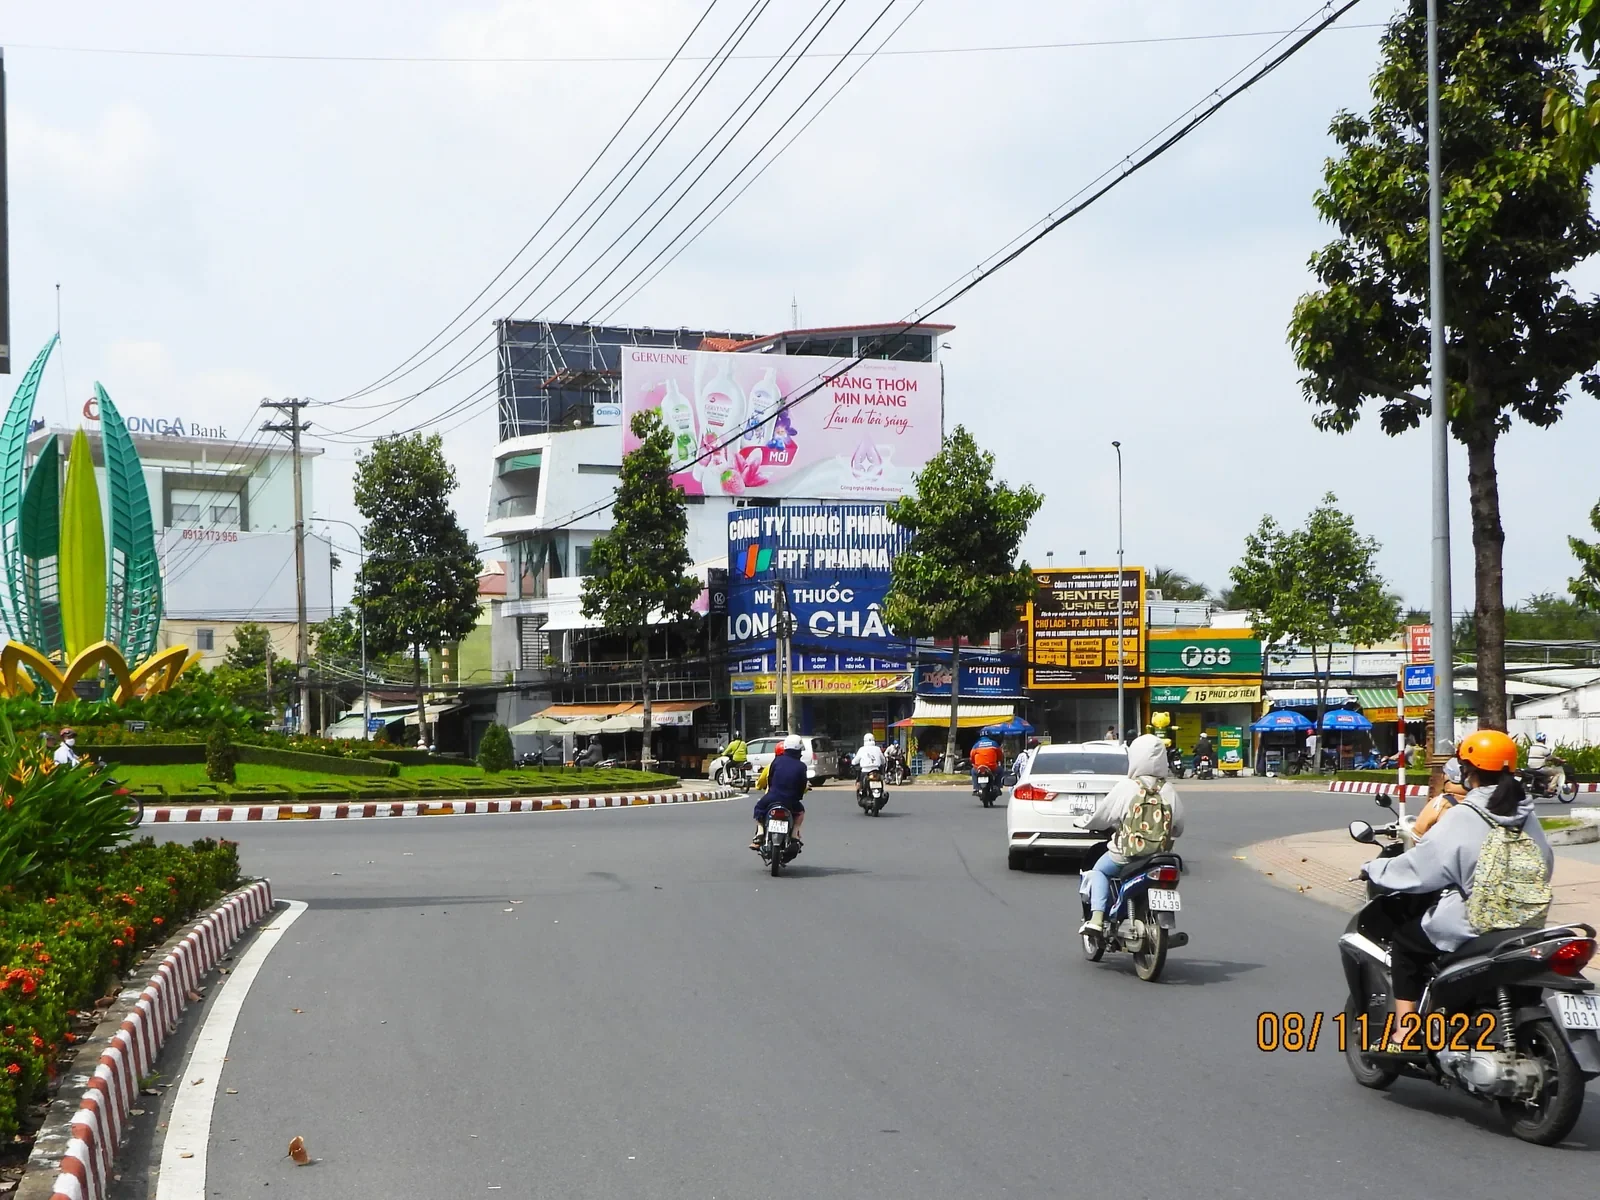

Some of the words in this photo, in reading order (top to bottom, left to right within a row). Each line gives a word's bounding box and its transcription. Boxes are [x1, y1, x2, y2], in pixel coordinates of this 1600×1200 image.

[632, 352, 688, 365] GERVENNE
[822, 372, 872, 390] TRẮNG
[876, 378, 917, 392] THƠM
[834, 392, 860, 407] MỊN
[864, 391, 907, 407] MÀNG
[123, 416, 186, 436] ONGA
[190, 422, 228, 439] Bank
[851, 409, 864, 424] da
[884, 414, 914, 435] sáng
[769, 450, 789, 463] MỚI
[183, 529, 203, 540] 0913
[206, 530, 220, 541] 173
[222, 531, 238, 542] 956
[729, 516, 760, 541] CÔNG
[764, 516, 786, 536] TY
[778, 549, 809, 569] FPT
[814, 549, 890, 569] PHARMA
[793, 581, 854, 604] THUỐC
[1035, 619, 1049, 630] CHỢ
[1050, 617, 1066, 628] LÁCH
[1096, 618, 1108, 627] TRE
[1124, 618, 1139, 627] HCM
[1181, 645, 1231, 667] F88
[977, 676, 1001, 686] LINH
[1195, 690, 1207, 702] 15
[1153, 890, 1176, 900] 71-B1
[1151, 899, 1181, 910] 514.39
[1563, 1011, 1600, 1027] 303.1
